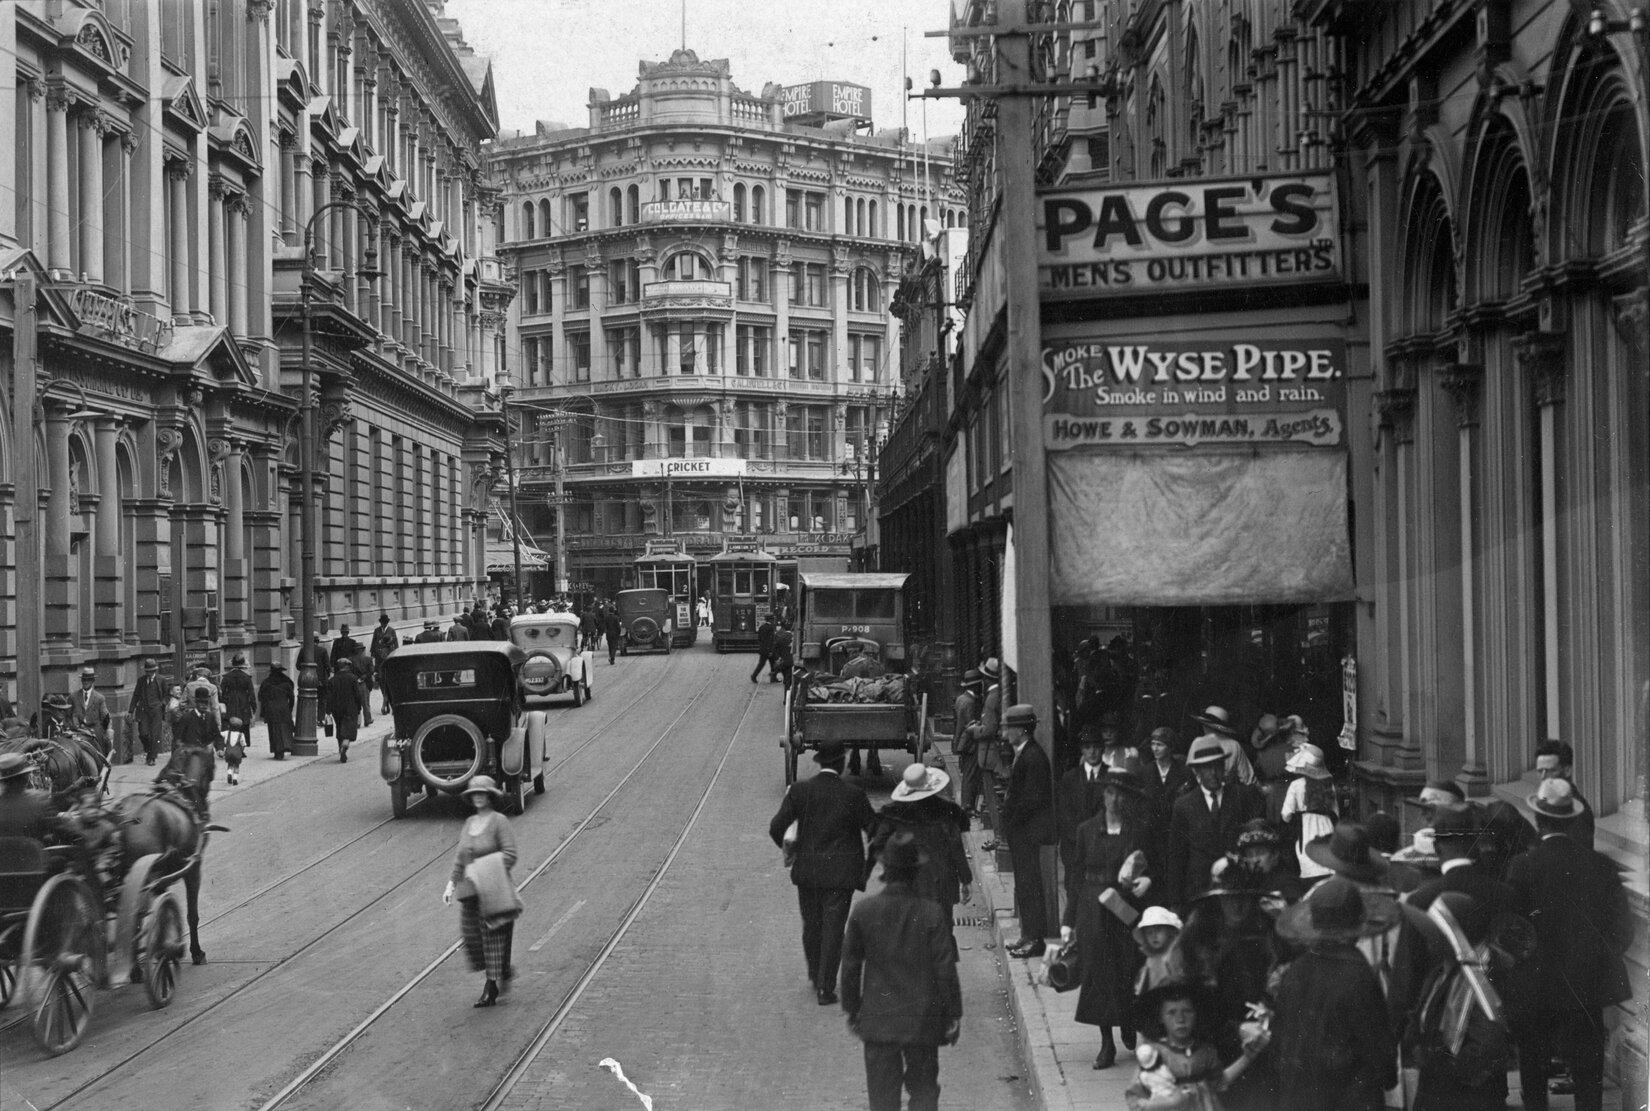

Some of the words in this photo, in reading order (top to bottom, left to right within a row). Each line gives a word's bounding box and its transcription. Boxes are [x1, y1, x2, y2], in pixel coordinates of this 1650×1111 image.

[833, 83, 863, 102] EMPIRE
[833, 98, 863, 116] HOTEL
[648, 202, 702, 213] COLGATE
[1043, 179, 1319, 252] PAGE'S
[1063, 362, 1104, 389] The
[1107, 345, 1227, 381] WYSE
[1233, 344, 1342, 379] PIPE.
[1096, 386, 1156, 405] Smoke
[1162, 387, 1179, 404] in
[1184, 386, 1226, 403] wind
[1236, 385, 1270, 402] and
[1052, 419, 1113, 440] HOWE
[1120, 421, 1138, 439] &
[667, 462, 711, 472] CRICKET
[781, 545, 831, 554] RECORD
[682, 584, 688, 593] 2
[762, 584, 768, 593] 3
